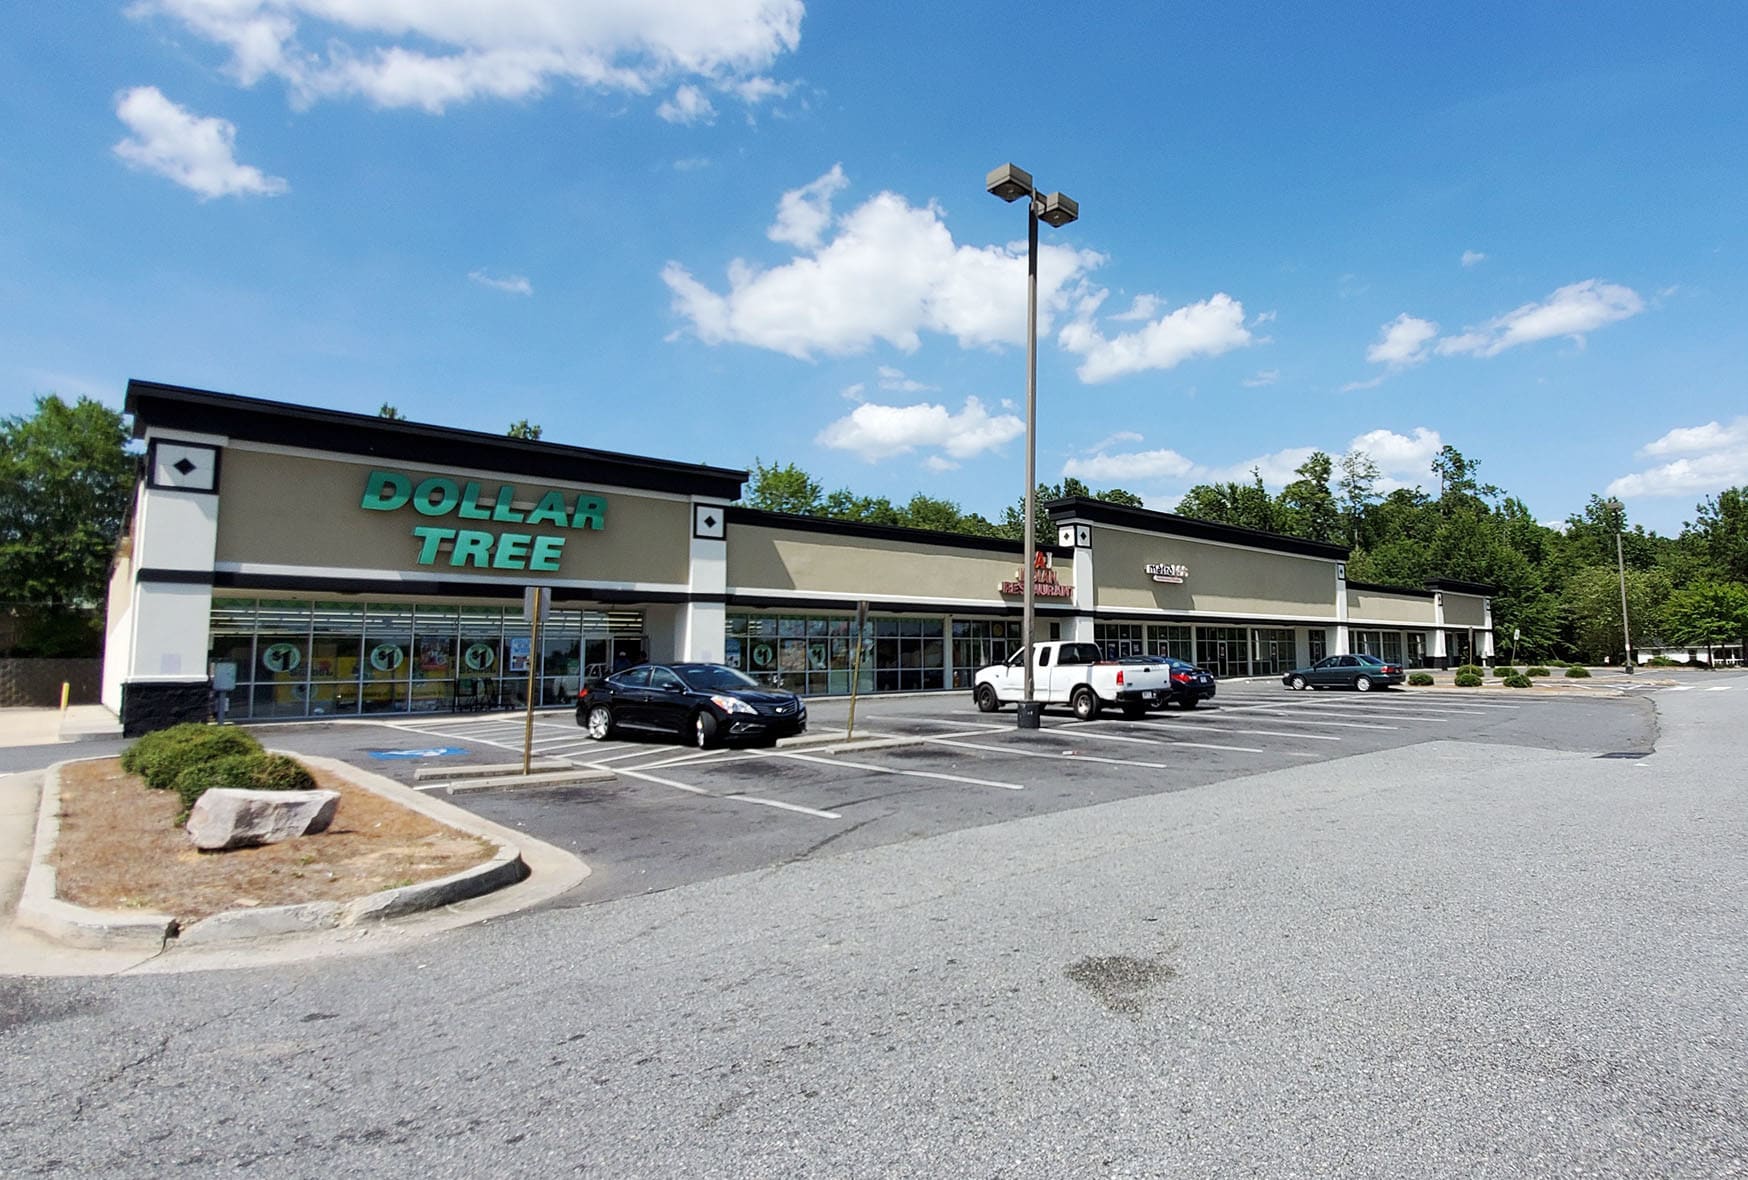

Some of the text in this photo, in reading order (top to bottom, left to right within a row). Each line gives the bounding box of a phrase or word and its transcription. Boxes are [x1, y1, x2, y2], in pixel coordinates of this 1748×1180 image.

[360, 470, 609, 530] DOLLAR
[413, 526, 566, 571] TREE
[1018, 567, 1057, 584] IIAN
[1001, 581, 1075, 597] RESAURANT
[378, 650, 396, 670] $1
